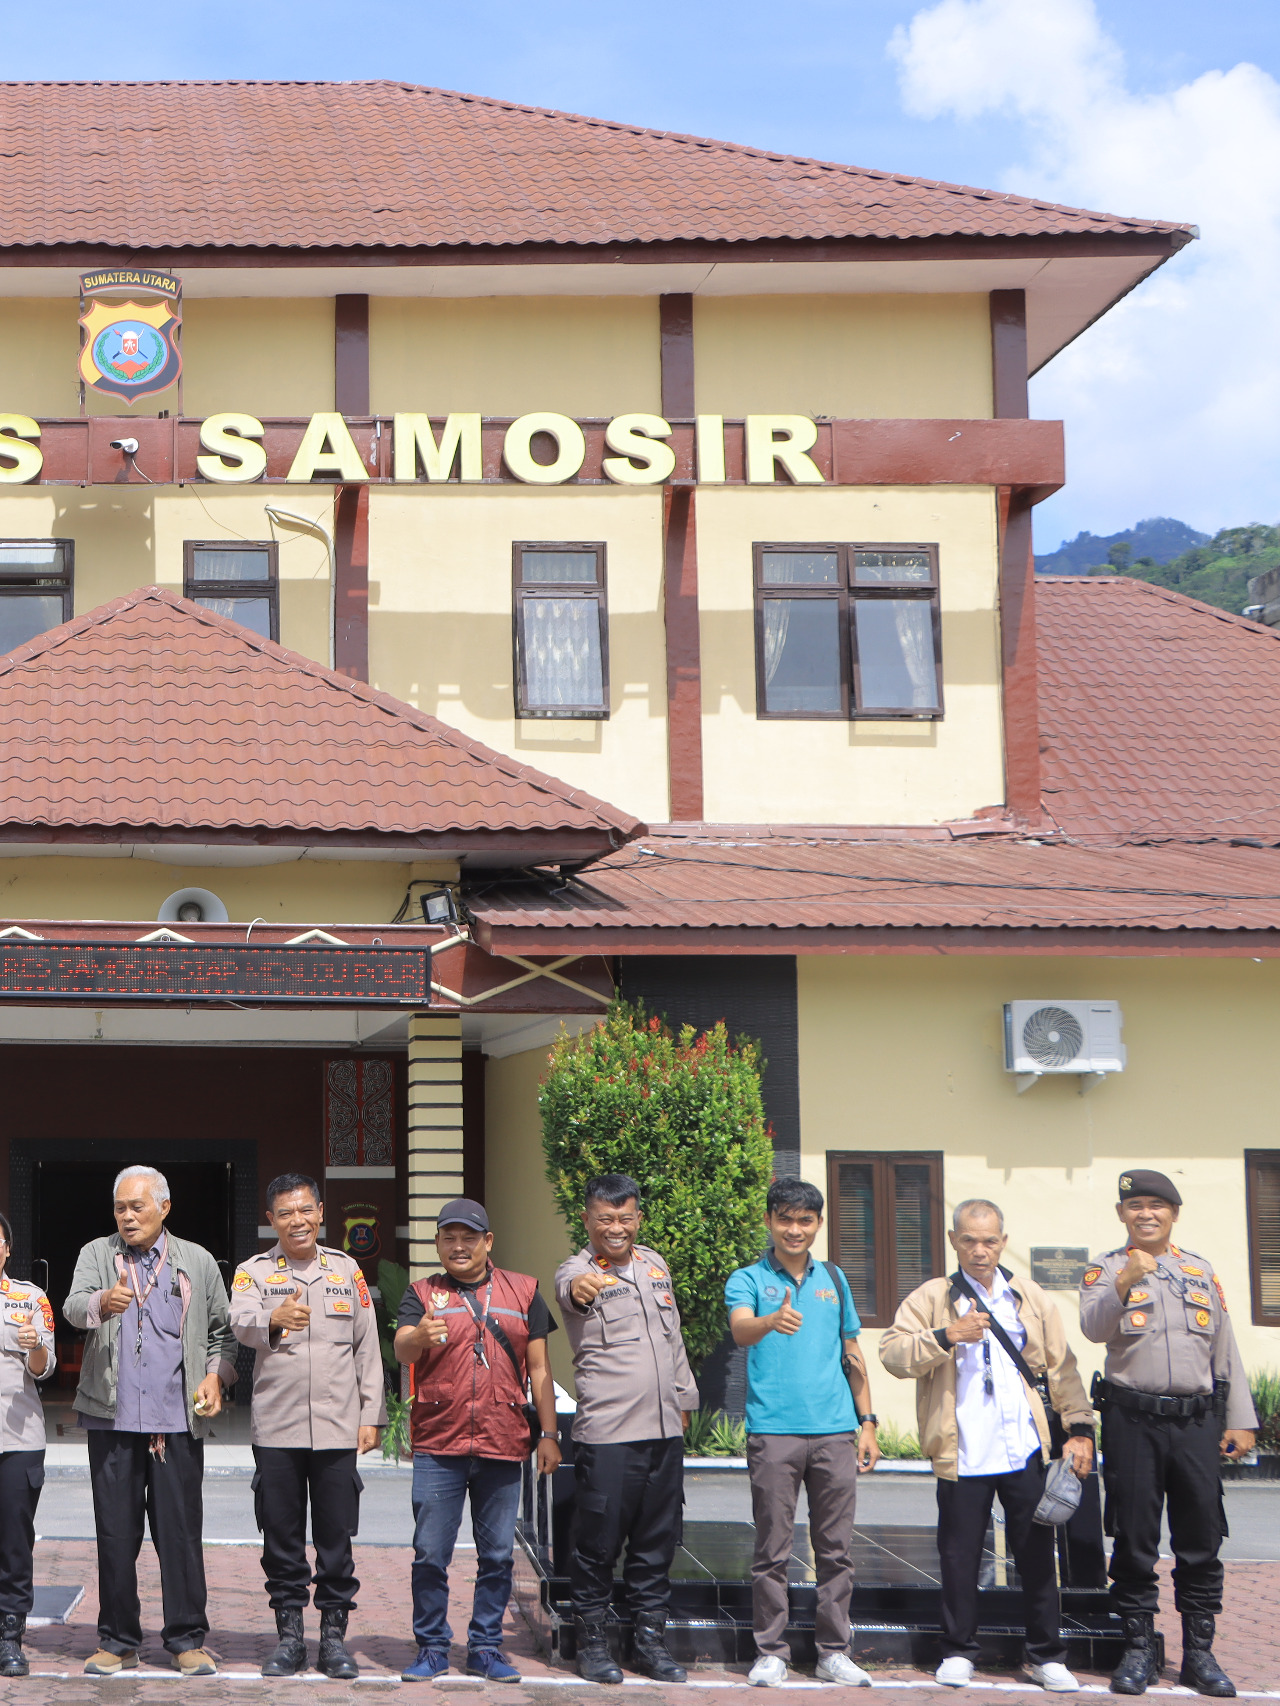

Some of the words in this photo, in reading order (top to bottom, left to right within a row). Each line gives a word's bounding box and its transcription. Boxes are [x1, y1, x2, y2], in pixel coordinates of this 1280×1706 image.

[84, 271, 140, 288] SUMATERA
[143, 273, 177, 292] UTARA
[196, 411, 826, 484] SAMOSIR
[59, 959, 172, 980] SAMOSIR
[326, 1287, 352, 1296] POLRI
[4, 1302, 33, 1311] POLRI
